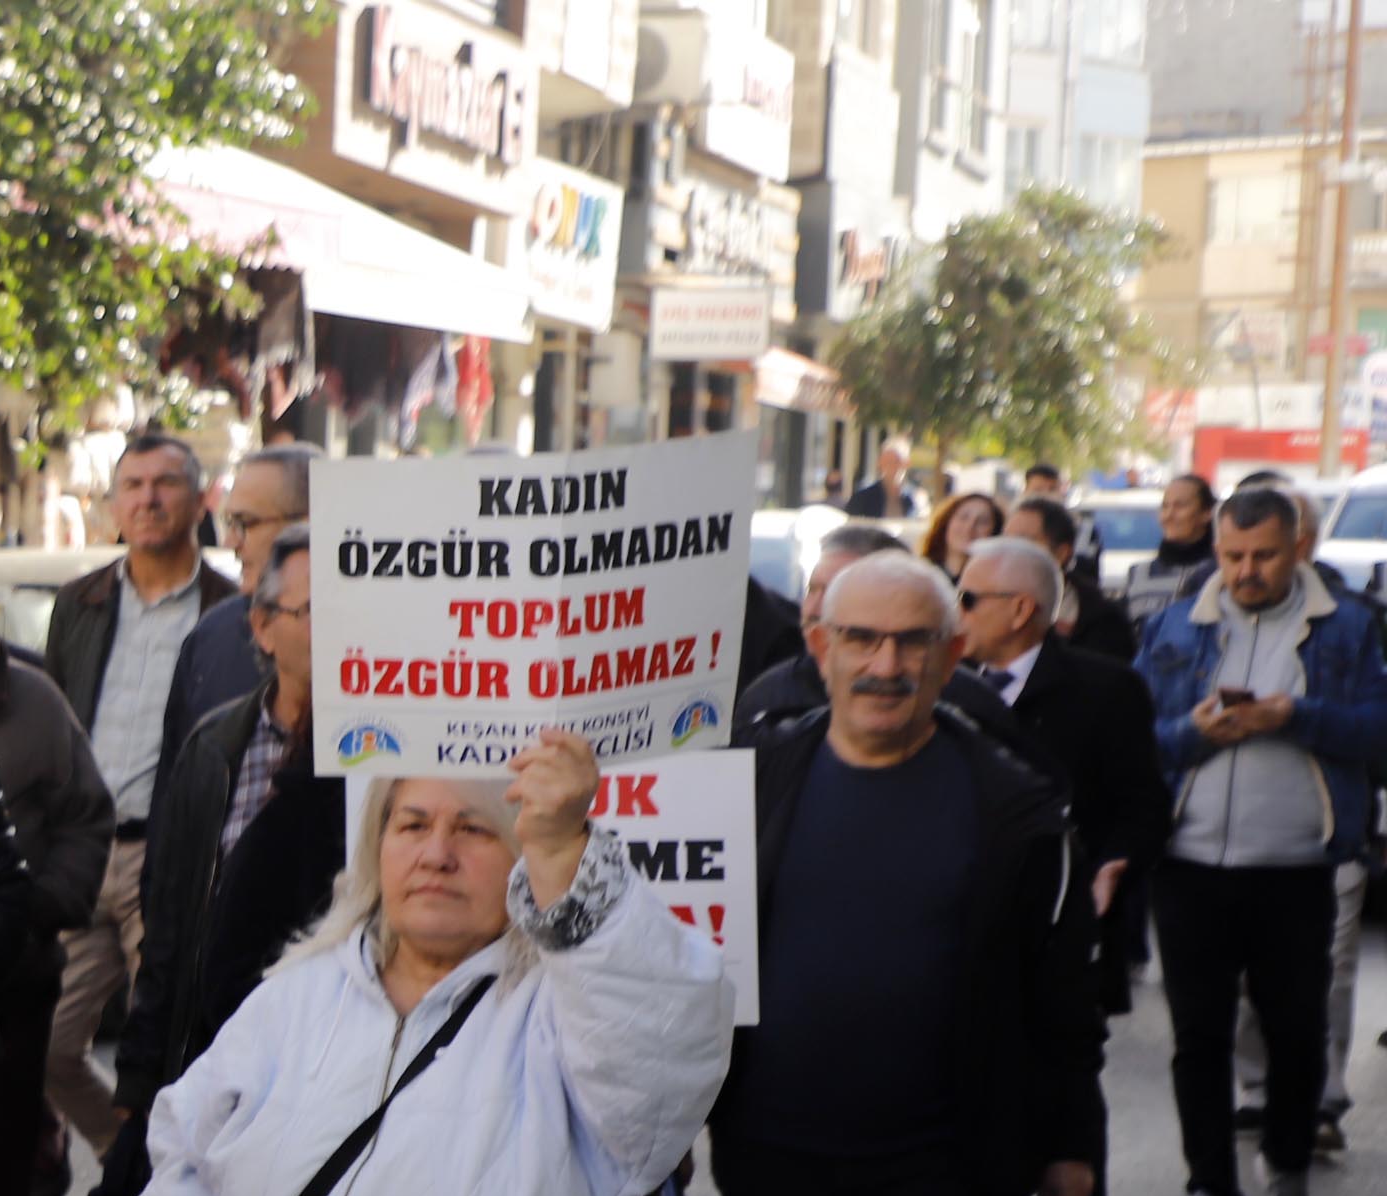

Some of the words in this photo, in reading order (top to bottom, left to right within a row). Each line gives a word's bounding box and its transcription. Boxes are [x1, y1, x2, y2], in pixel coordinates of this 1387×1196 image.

[477, 467, 628, 518] KADIN
[338, 529, 511, 579] ÖZGÜR
[529, 513, 733, 578] OLMADAN
[448, 587, 646, 640] TOPLUM
[340, 648, 510, 699] ÖZGÜR
[528, 636, 697, 700] OLAMAZ
[447, 720, 517, 739] KEŞAN
[582, 704, 650, 735] KONSEYİ
